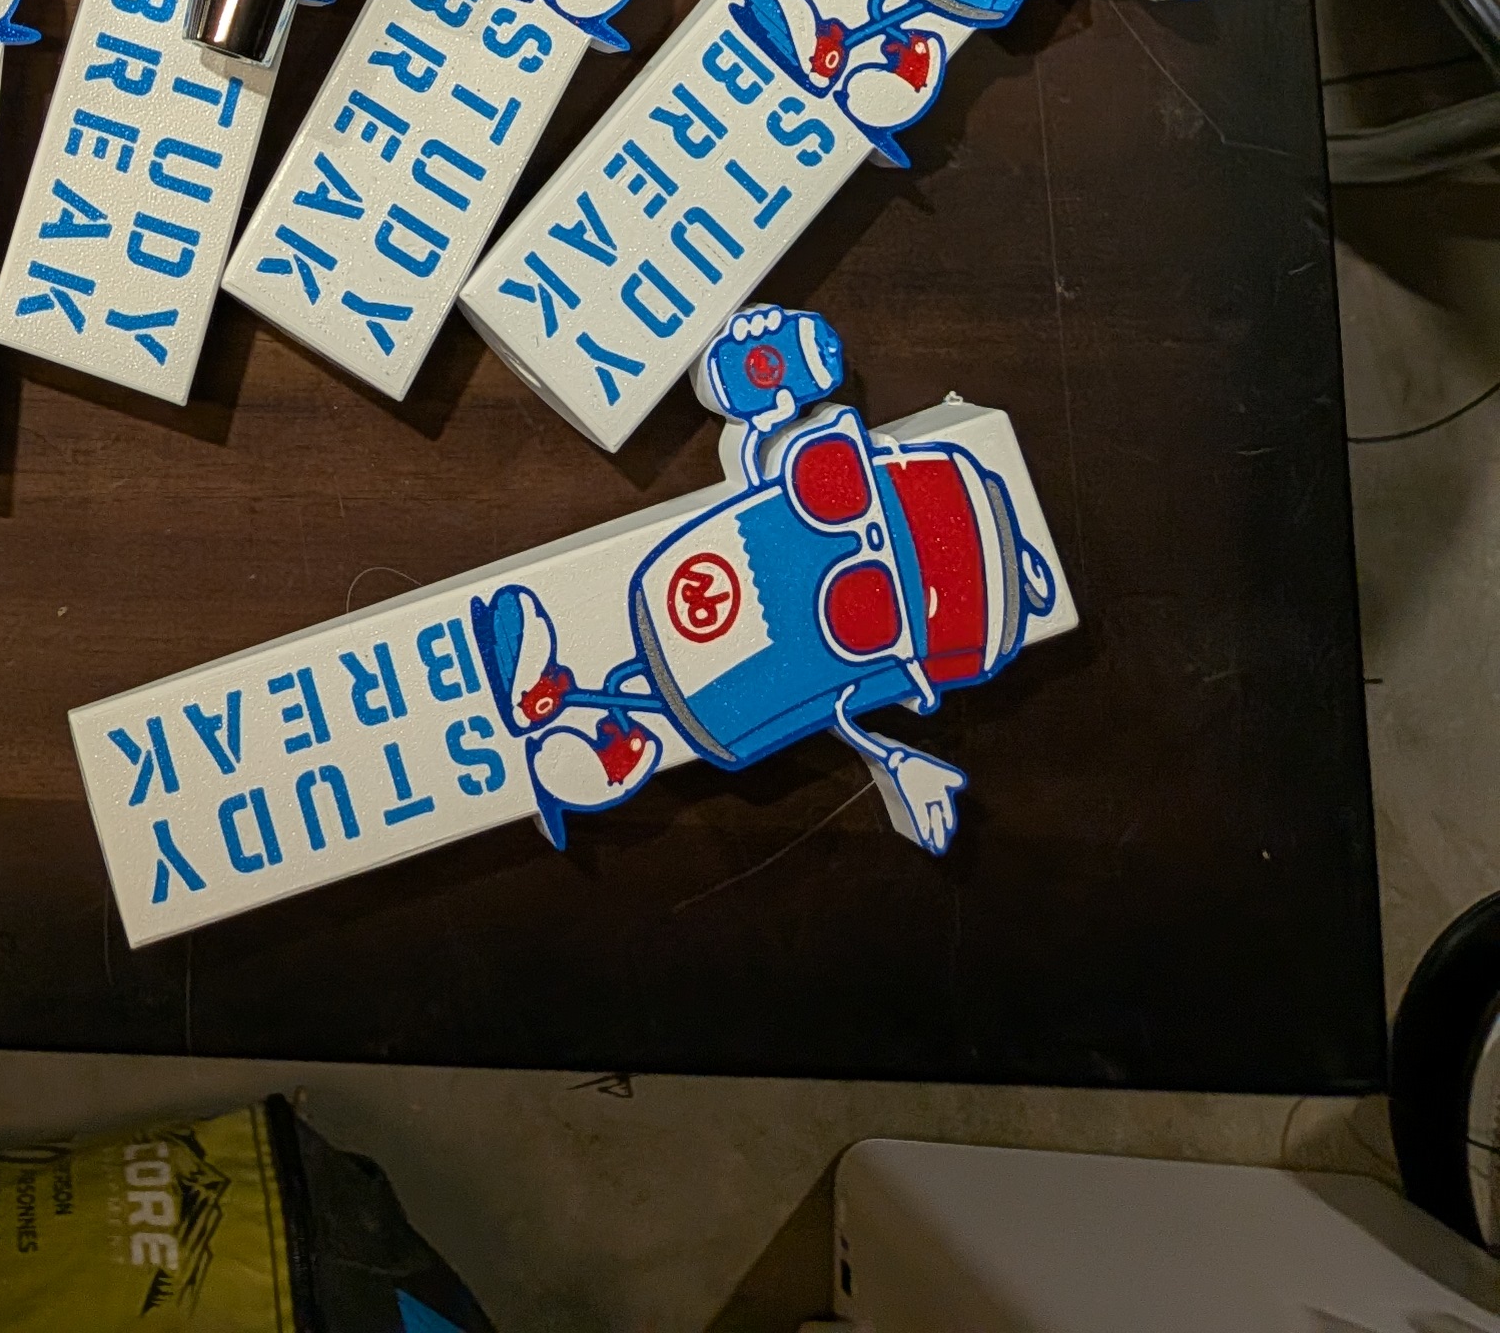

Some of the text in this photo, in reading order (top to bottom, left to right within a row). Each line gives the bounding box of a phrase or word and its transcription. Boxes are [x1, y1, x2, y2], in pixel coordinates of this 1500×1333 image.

[103, 75, 244, 366] TUDY
[341, 5, 552, 355] STUDY
[498, 48, 765, 339] BREAK
[575, 98, 836, 405] STUDY
[108, 620, 469, 806] BREAK
[150, 719, 507, 905] STUDY
[122, 1141, 180, 1271] CORE
